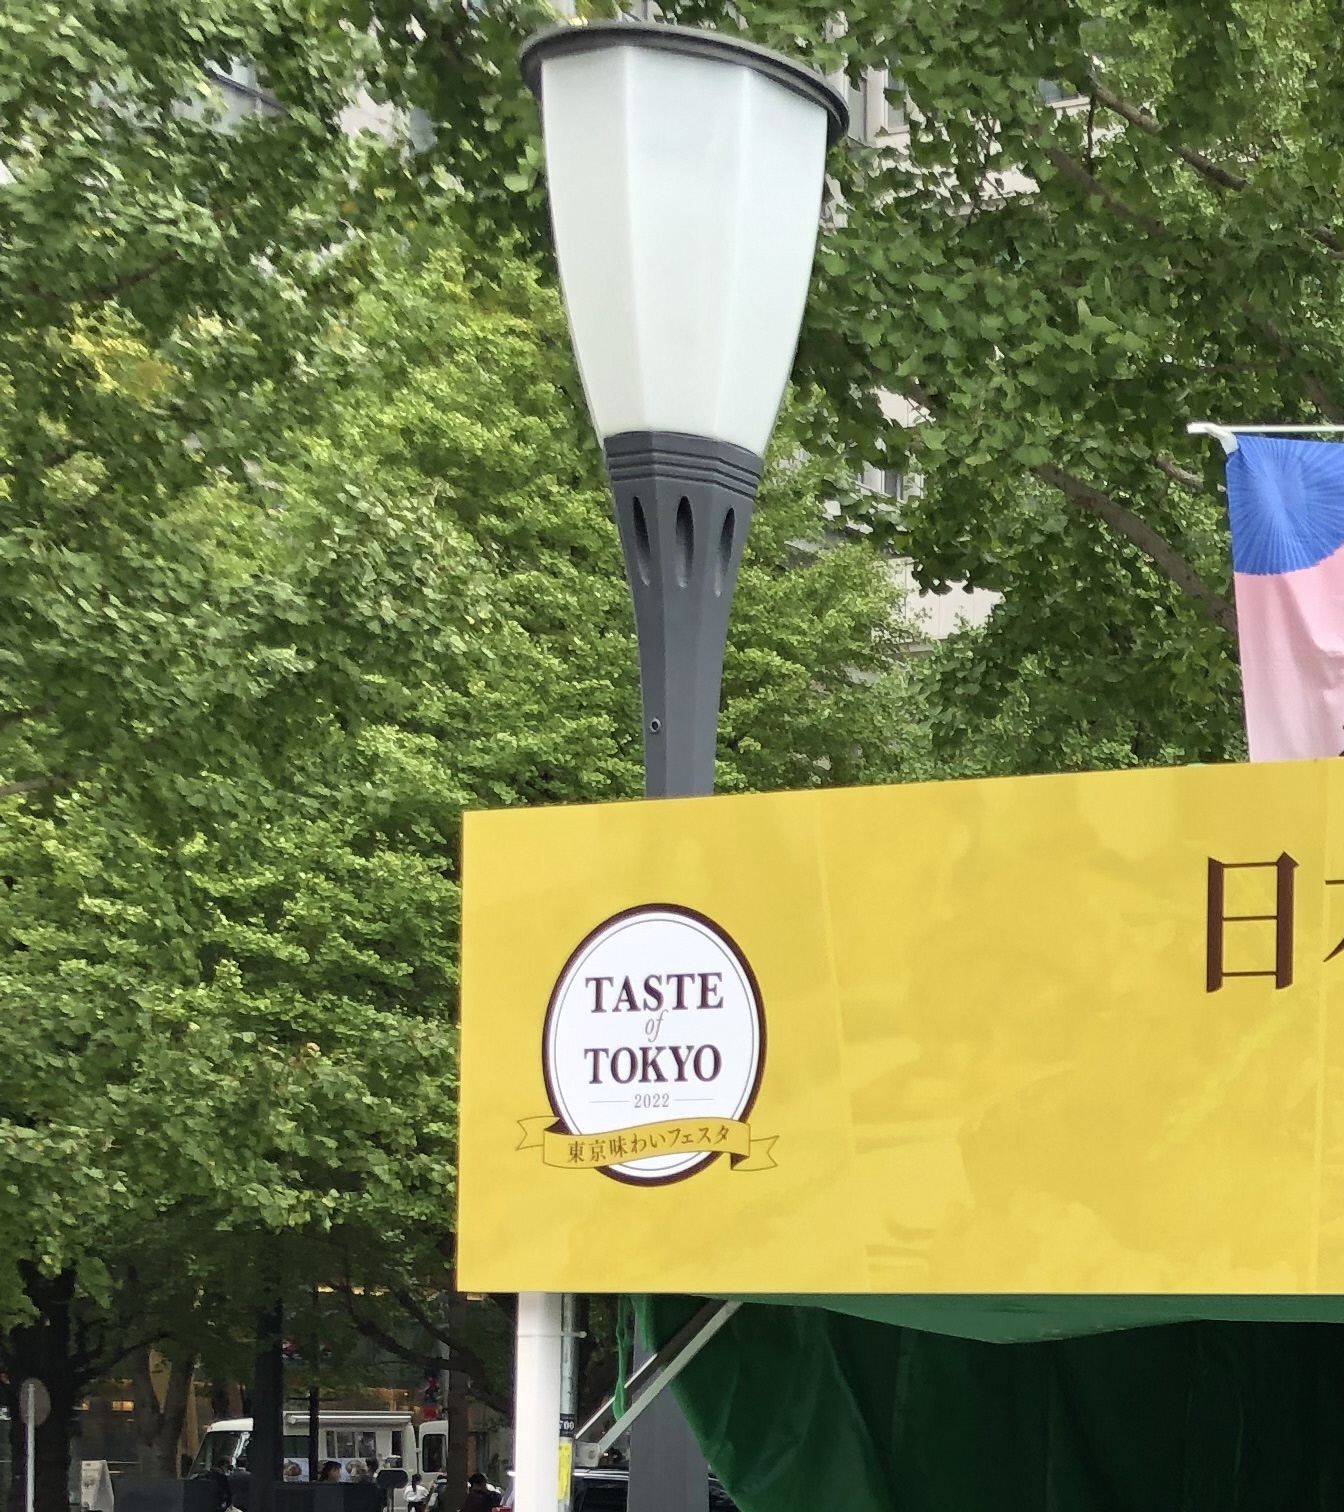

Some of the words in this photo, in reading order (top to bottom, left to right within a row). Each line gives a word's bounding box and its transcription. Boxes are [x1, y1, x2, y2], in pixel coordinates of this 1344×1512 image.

[584, 972, 724, 1016] TASTE
[645, 1010, 663, 1040] of
[584, 1044, 721, 1085] TOKYO
[634, 1092, 670, 1109] 2022
[566, 1123, 731, 1165] 東京味わいフェスタ
